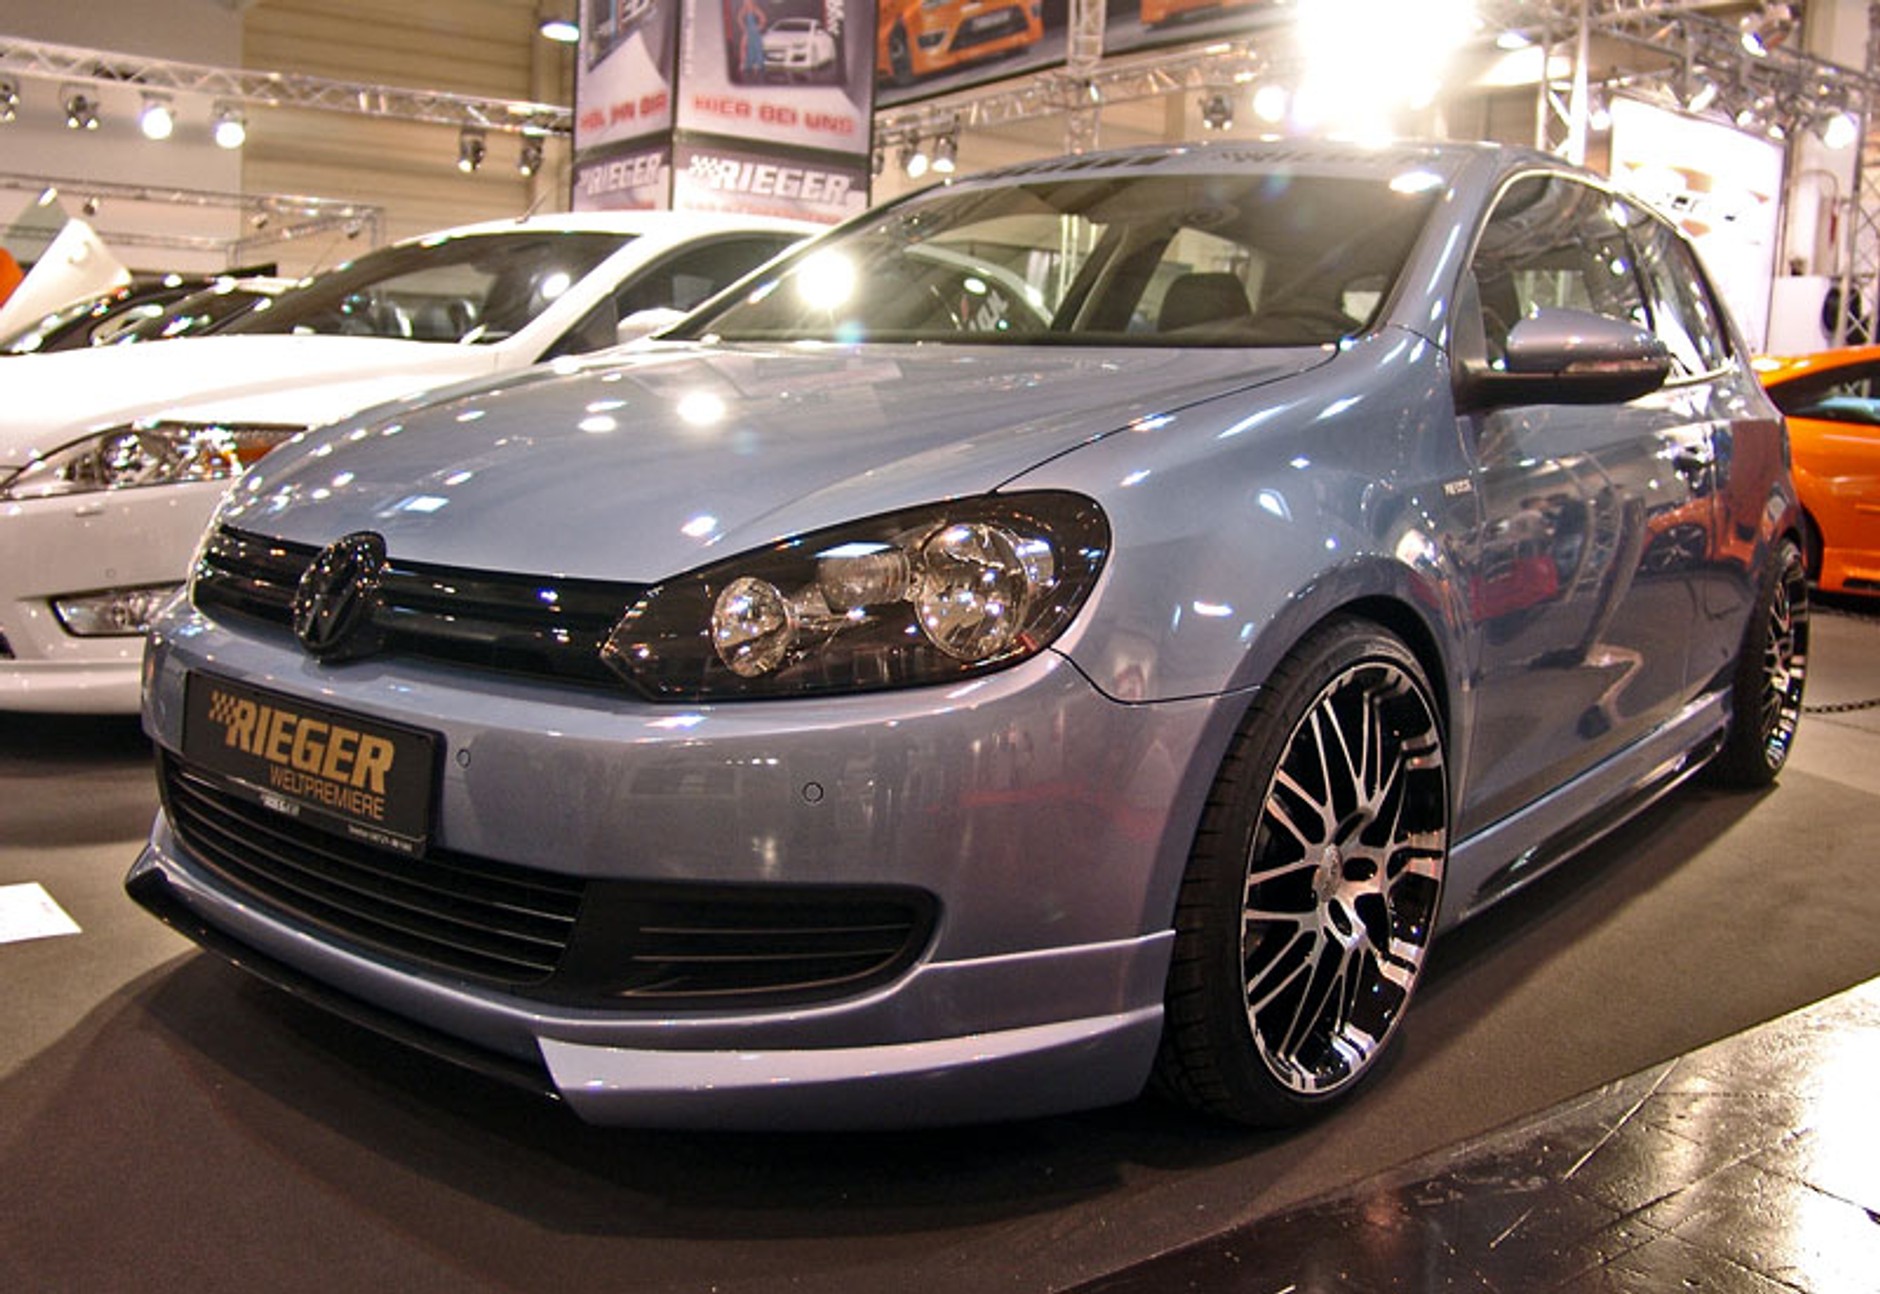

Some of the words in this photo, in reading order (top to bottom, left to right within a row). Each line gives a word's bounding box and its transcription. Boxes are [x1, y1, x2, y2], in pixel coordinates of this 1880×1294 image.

[759, 104, 798, 126] BEI
[805, 111, 855, 134] UNS
[587, 152, 663, 196] RIEGER
[709, 157, 850, 204] RIEGER
[226, 699, 395, 795] RIEGER
[269, 764, 386, 821] WELTPREMIERE
